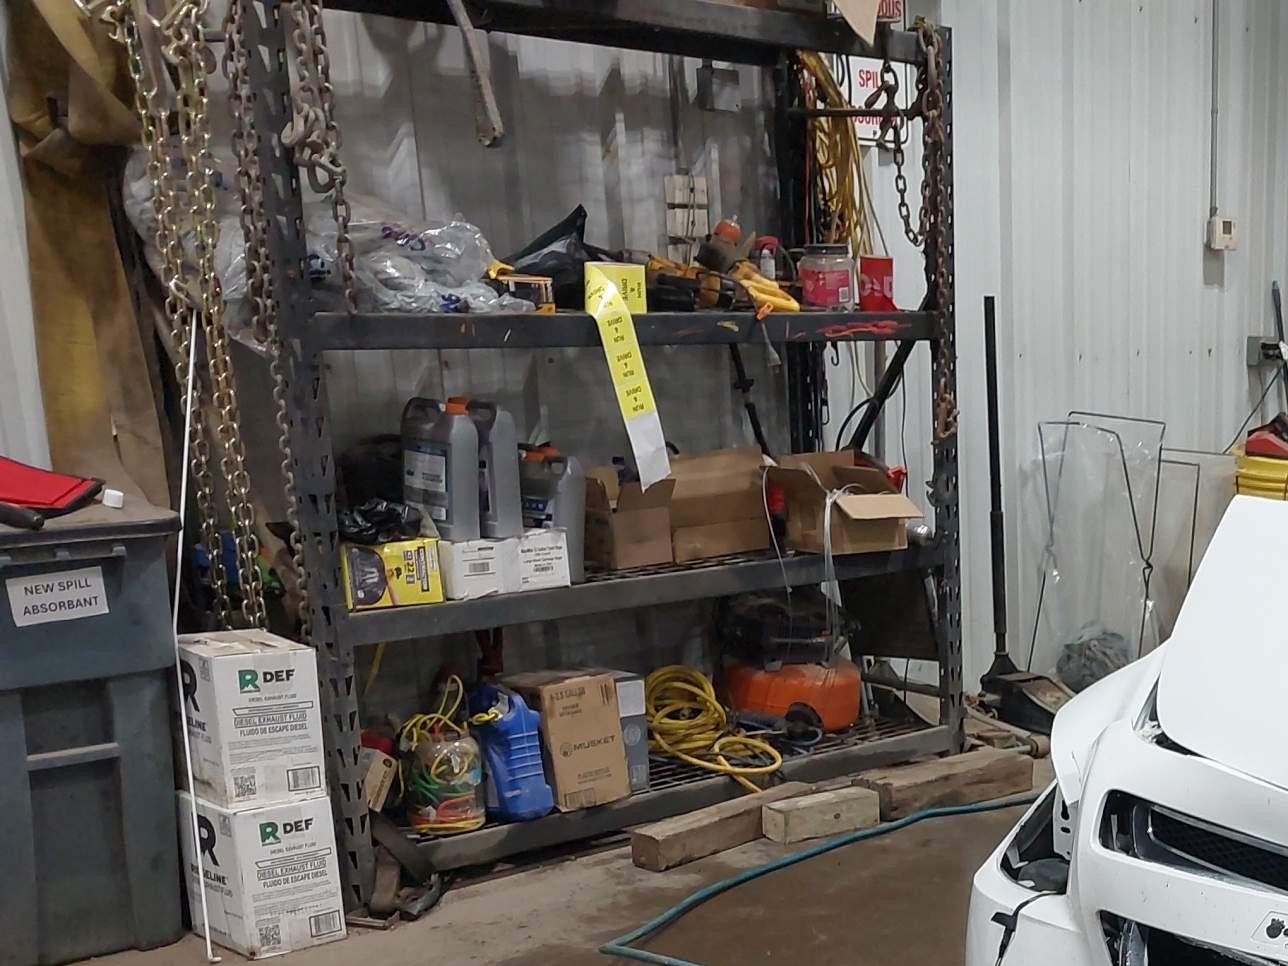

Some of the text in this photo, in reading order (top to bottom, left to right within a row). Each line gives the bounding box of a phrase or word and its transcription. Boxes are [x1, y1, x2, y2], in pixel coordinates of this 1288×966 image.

[858, 69, 882, 89] SPIL
[24, 578, 92, 596] NEW SPILL
[23, 595, 98, 617] ABSORBANT
[262, 669, 295, 683] DEF
[573, 735, 616, 752] MUSKET
[283, 818, 314, 834] DEF
